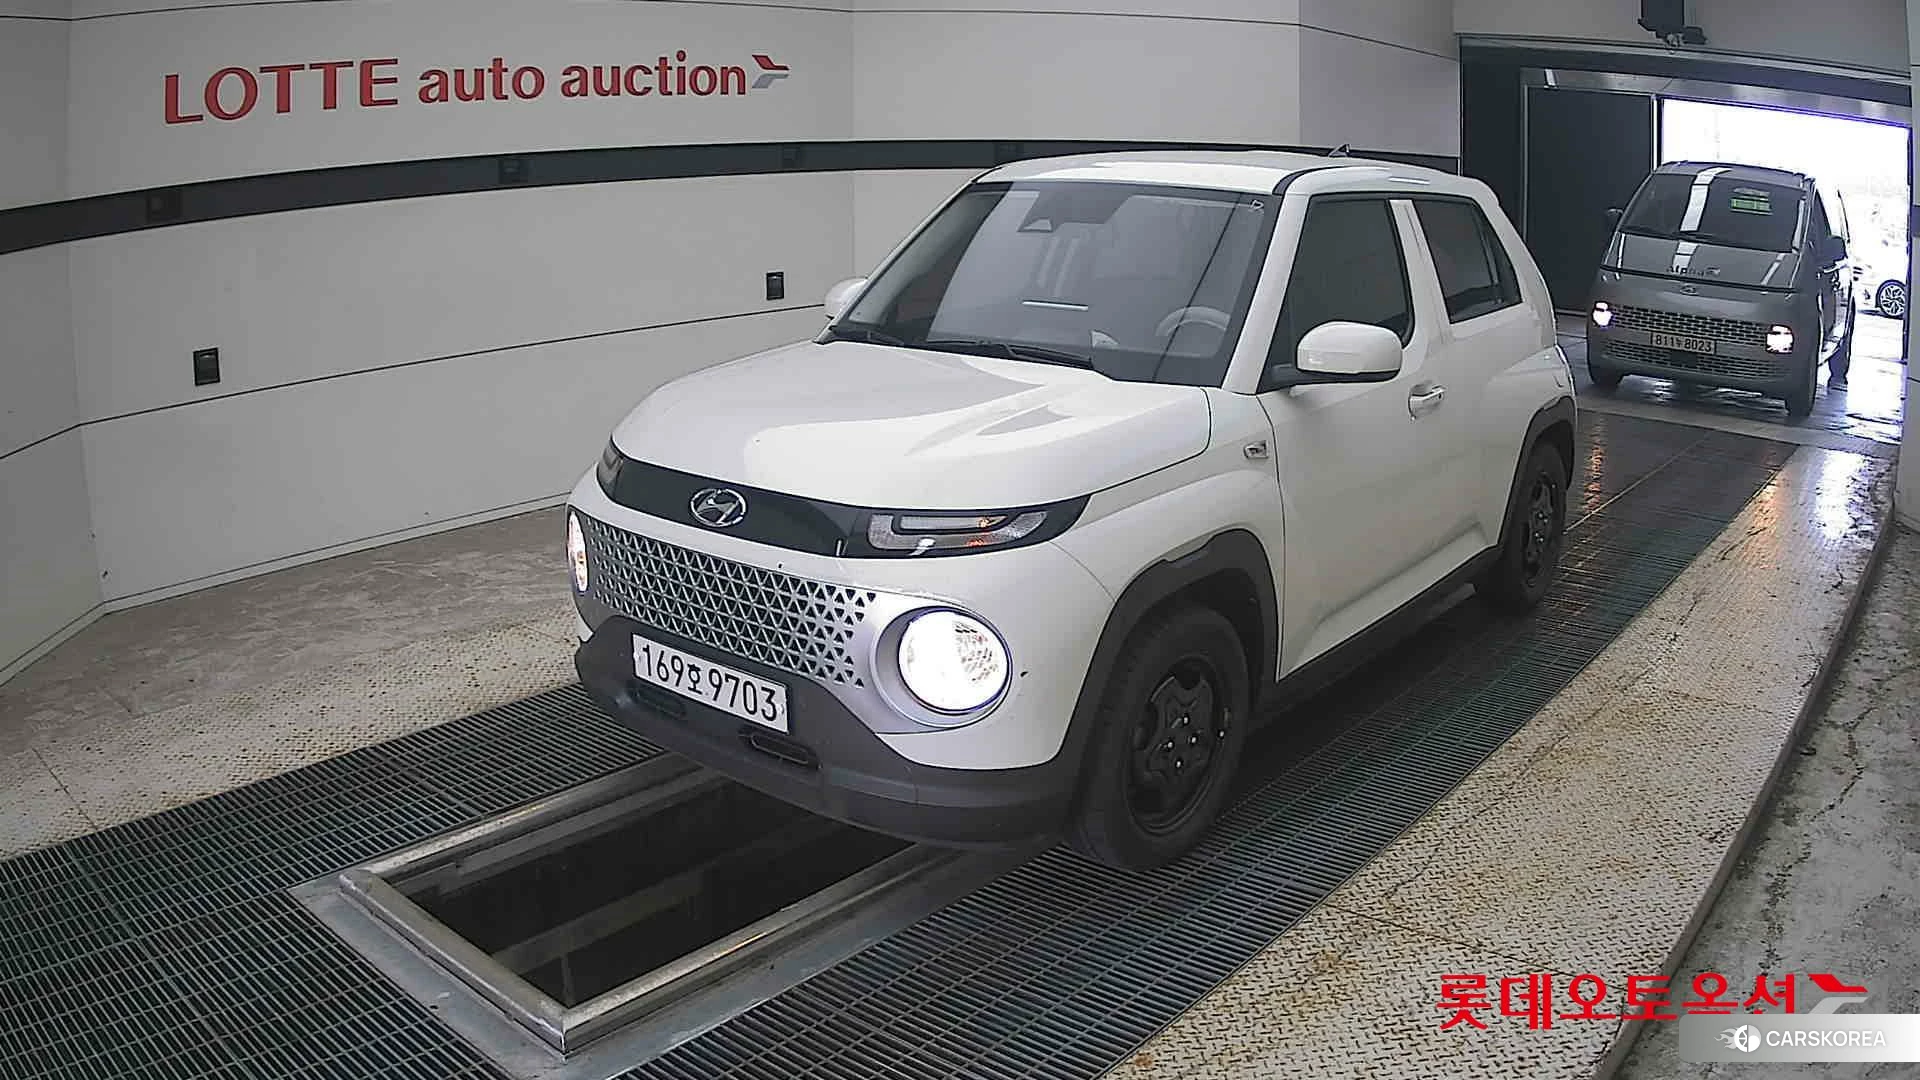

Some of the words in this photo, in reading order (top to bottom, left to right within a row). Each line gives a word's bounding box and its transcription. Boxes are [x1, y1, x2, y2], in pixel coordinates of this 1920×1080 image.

[164, 58, 399, 124] LOTTE
[418, 57, 546, 104] auto
[560, 50, 747, 98] auction
